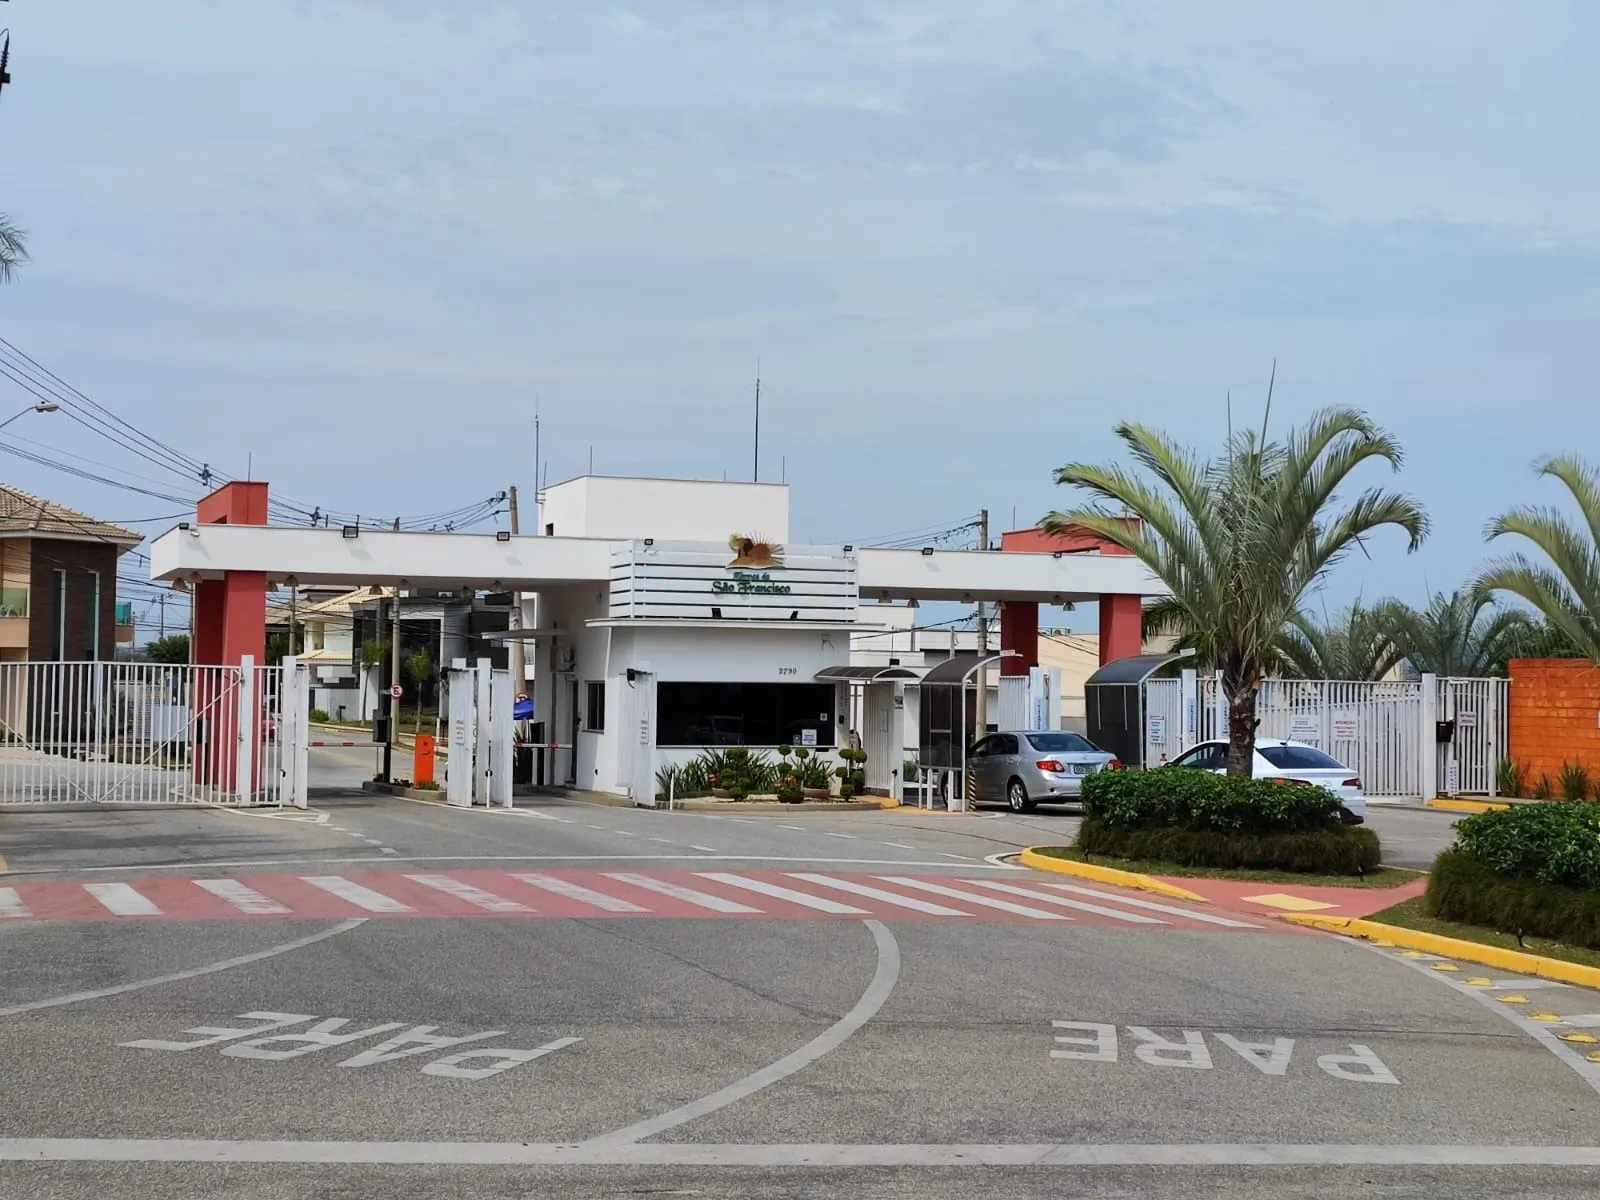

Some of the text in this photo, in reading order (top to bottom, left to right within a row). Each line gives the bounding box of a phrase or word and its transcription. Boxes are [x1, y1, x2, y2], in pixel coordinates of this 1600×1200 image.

[712, 580, 791, 594] São Francisco
[117, 1010, 584, 1080] PARE
[1049, 1020, 1401, 1085] PARE
